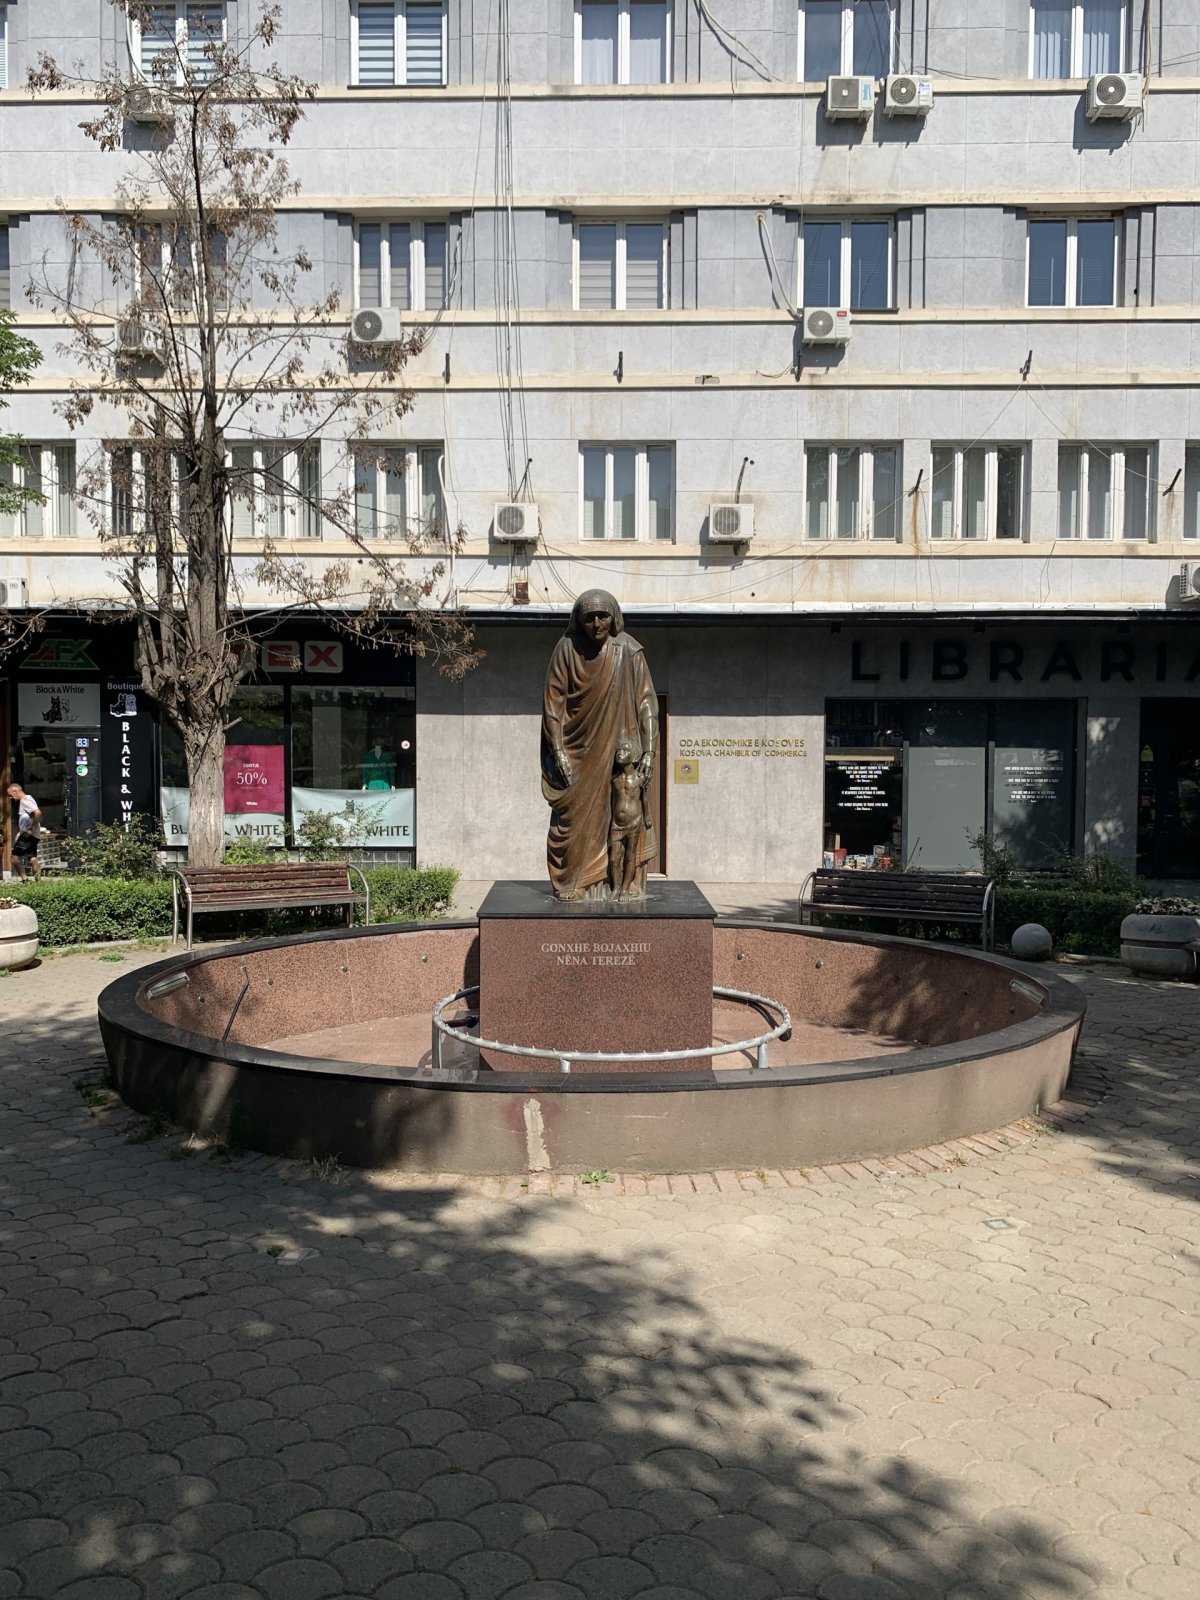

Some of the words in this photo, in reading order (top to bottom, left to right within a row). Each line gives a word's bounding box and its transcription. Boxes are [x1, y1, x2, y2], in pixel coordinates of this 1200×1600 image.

[77, 738, 88, 747] 83
[701, 739, 753, 748] EKONOMIKE
[121, 721, 131, 778] BLACK
[679, 749, 713, 757] KOSOVA
[713, 749, 750, 757] CHAMBER
[764, 749, 808, 757] COMMERCE
[236, 772, 268, 785] 50%
[120, 784, 132, 794] &
[120, 801, 133, 833] WHI
[235, 824, 280, 836] WHITE
[365, 825, 410, 837] WHITE
[541, 942, 590, 953] GONXHE
[593, 942, 652, 953] BOJAXHIU
[557, 954, 588, 966] NËNA
[592, 954, 636, 966] TEREZË
